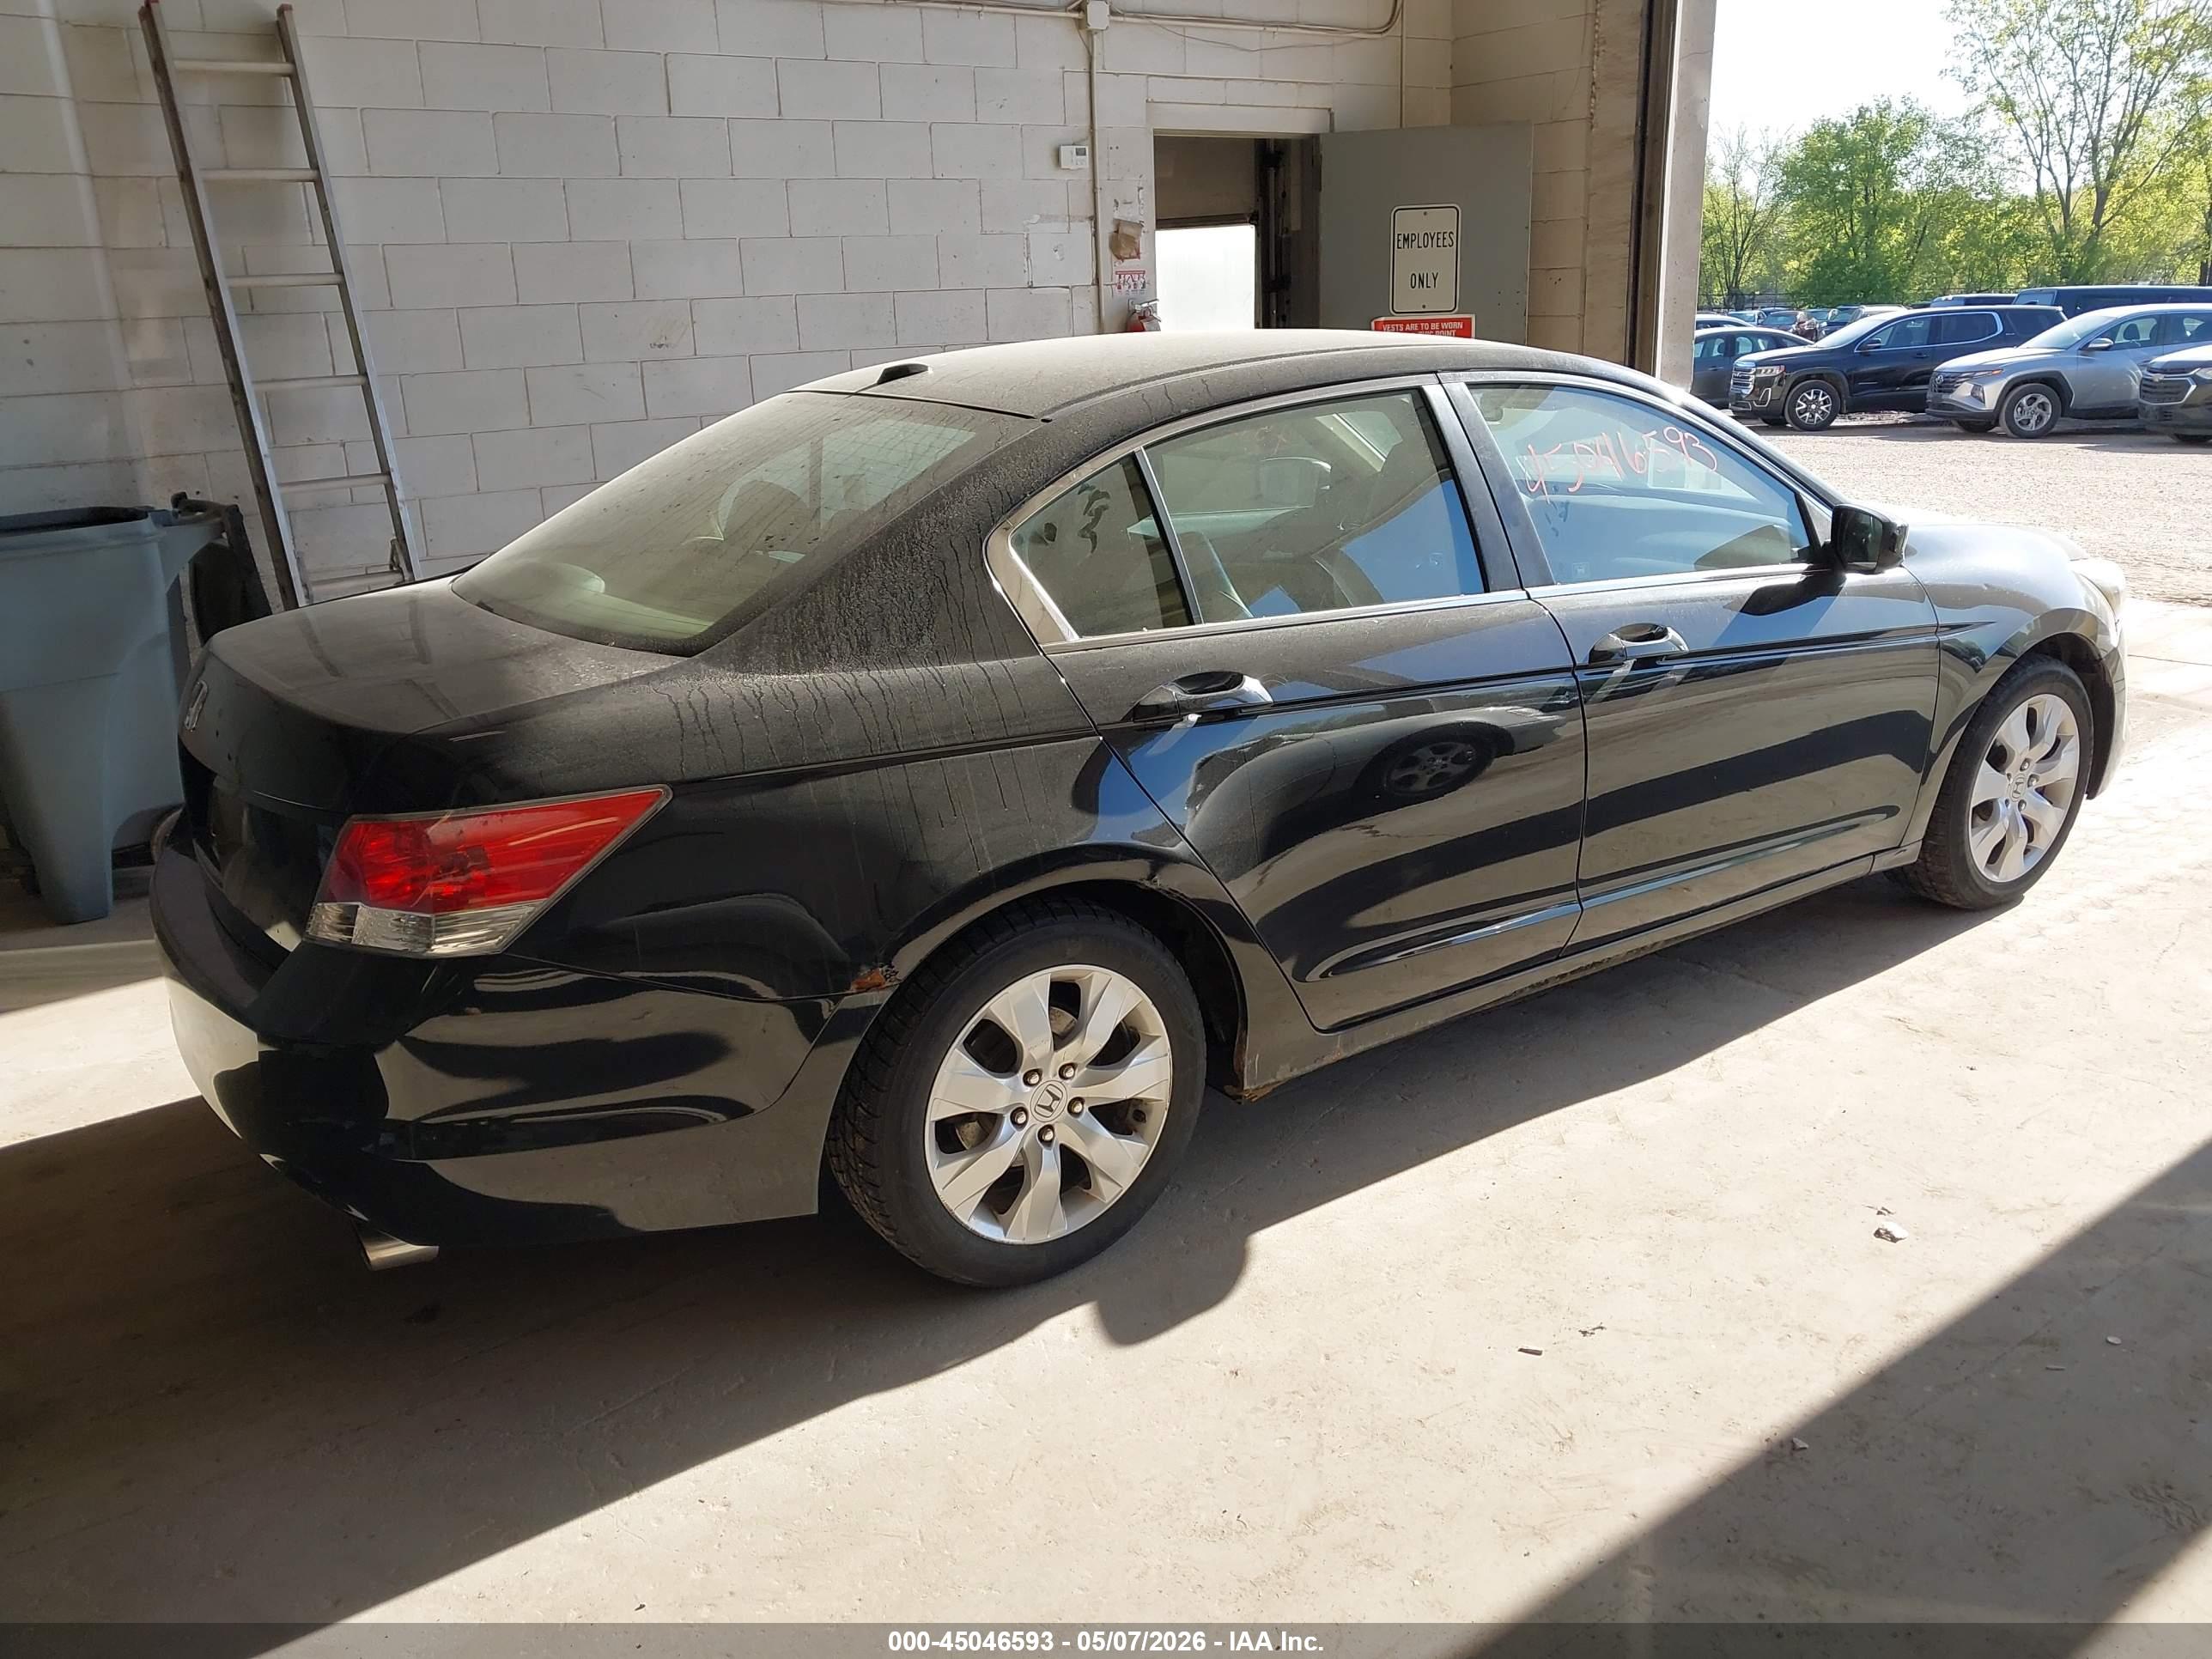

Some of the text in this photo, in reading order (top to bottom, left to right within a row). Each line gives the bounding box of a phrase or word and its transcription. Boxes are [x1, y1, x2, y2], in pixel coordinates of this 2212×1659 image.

[1396, 231, 1455, 249] EMPLOYEES
[1410, 272, 1438, 289] ONLY
[1441, 321, 1463, 330] WORN
